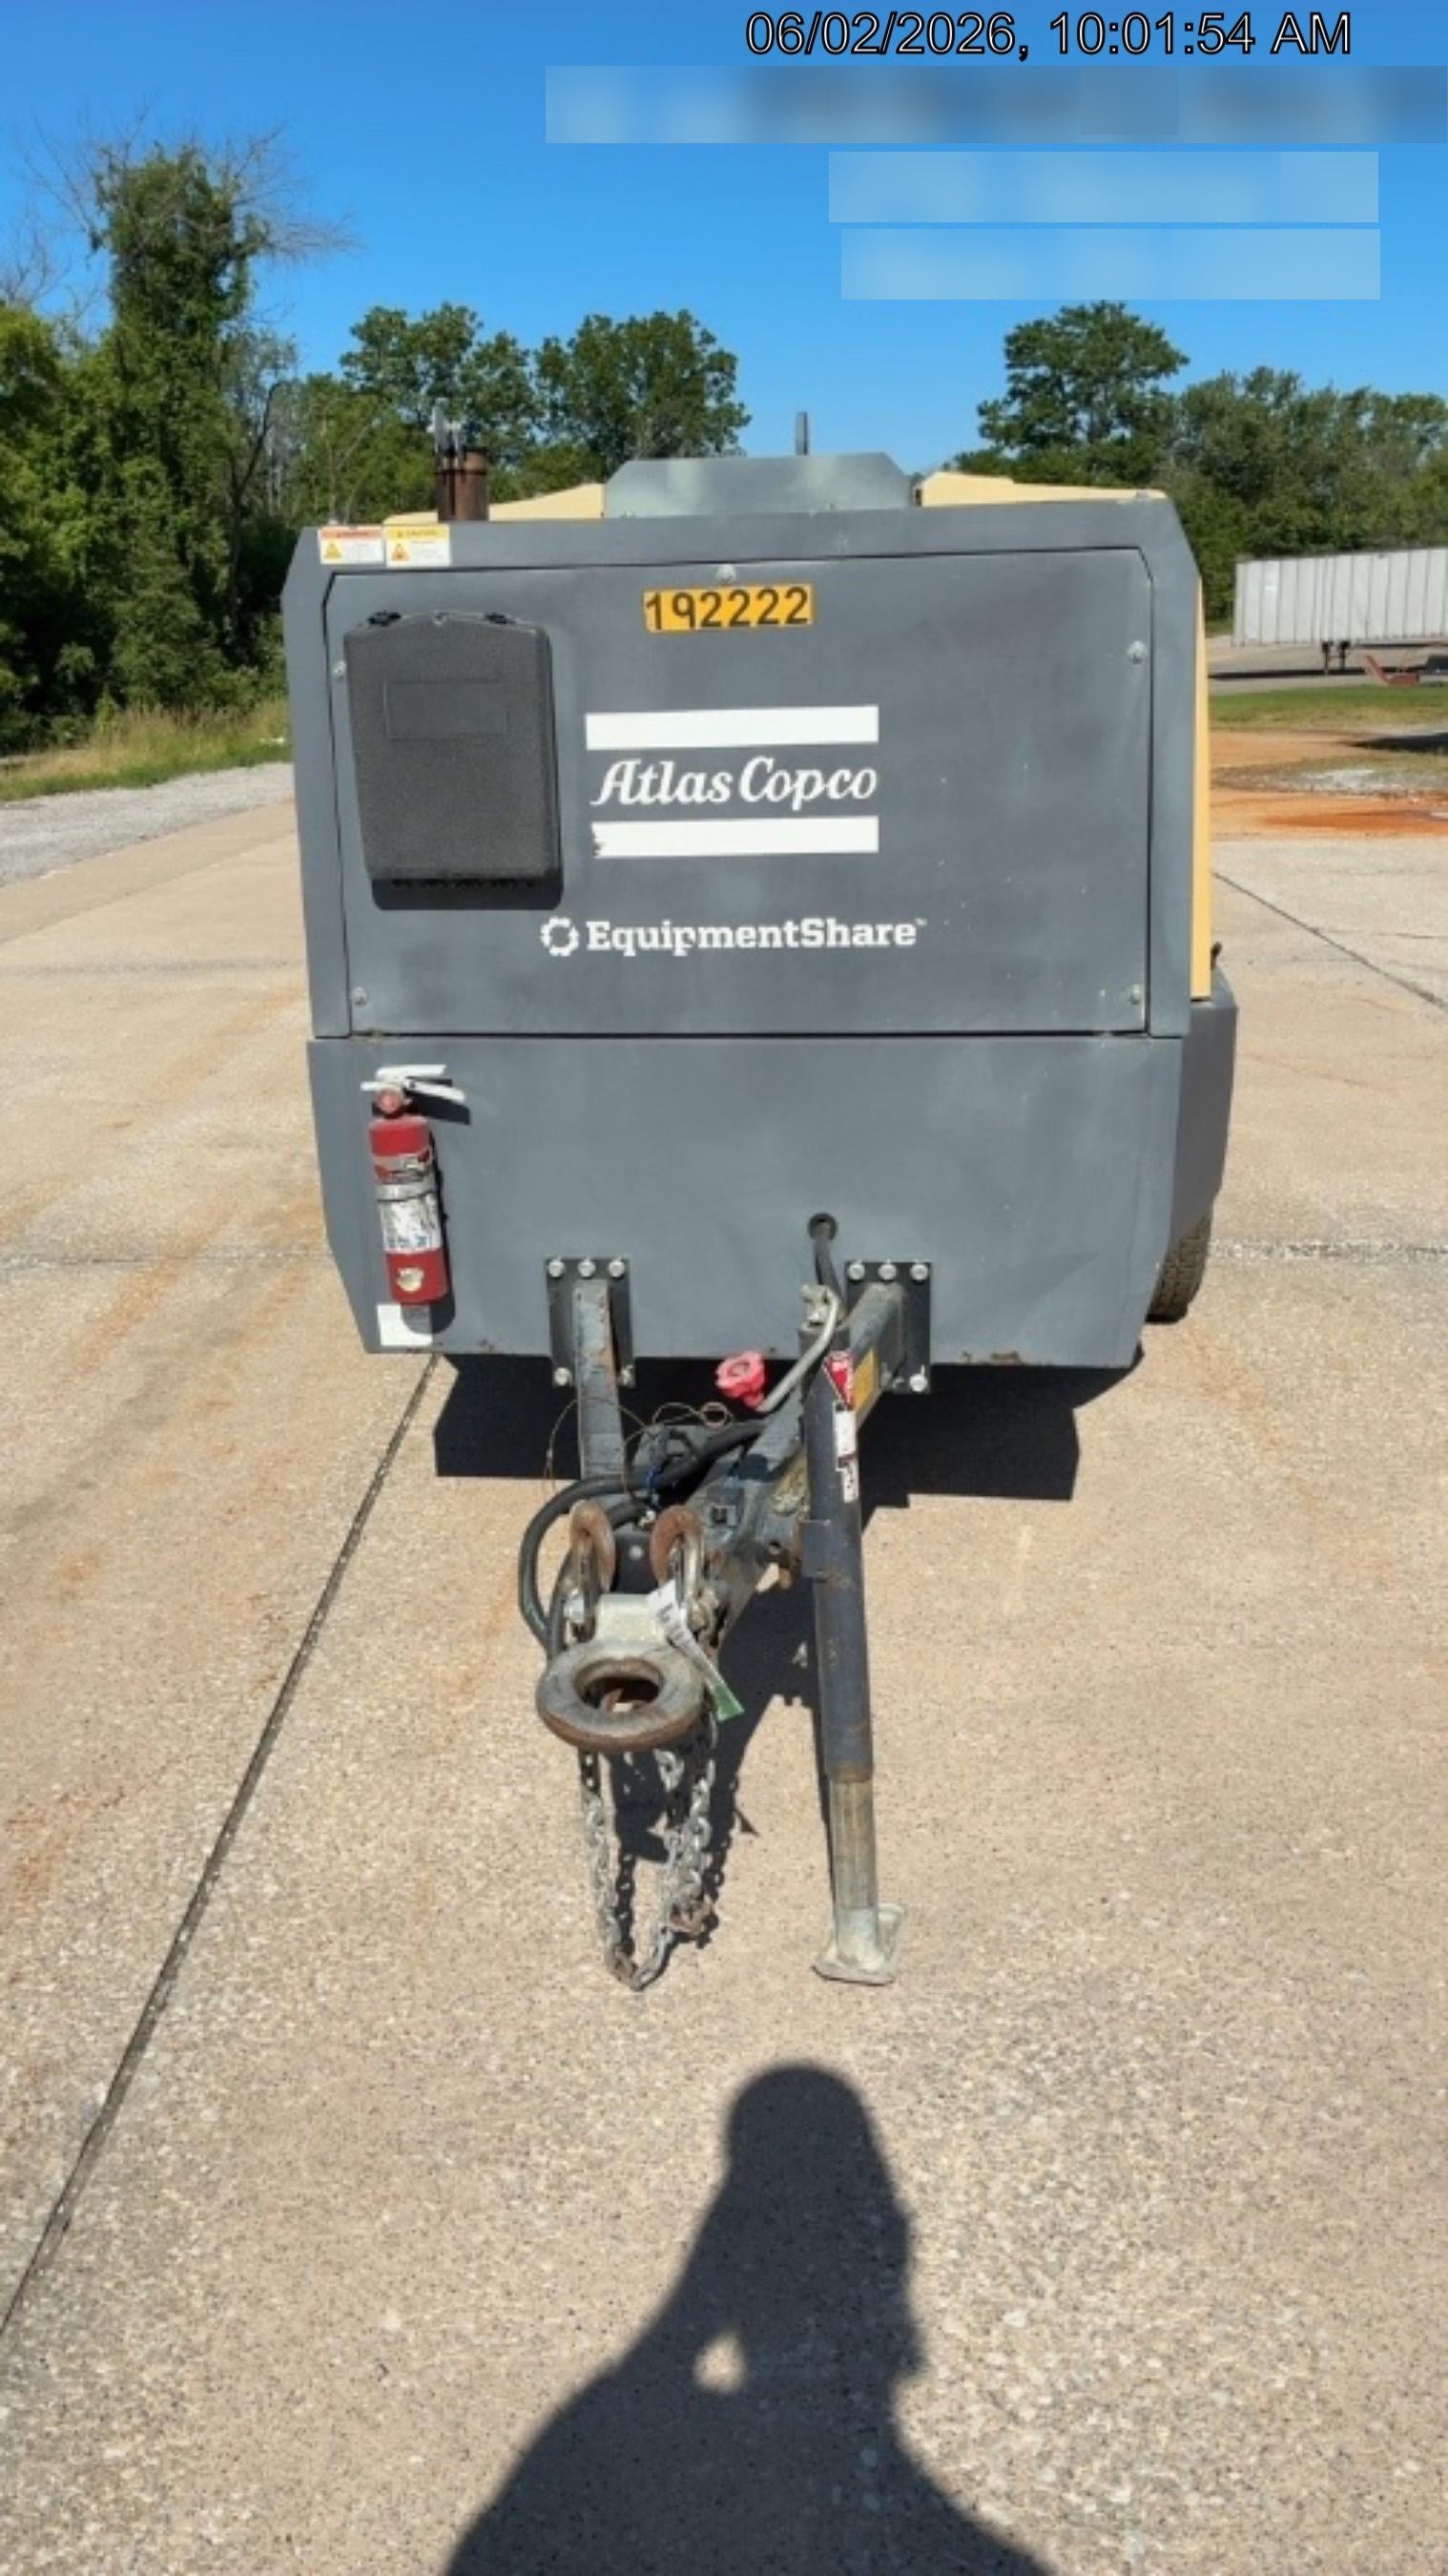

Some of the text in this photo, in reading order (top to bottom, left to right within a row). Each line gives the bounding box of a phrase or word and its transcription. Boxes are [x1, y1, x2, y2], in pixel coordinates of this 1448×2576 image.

[646, 587, 809, 631] 192222
[590, 756, 878, 811] Atlas Copco
[586, 917, 917, 955] EquipmentShare
